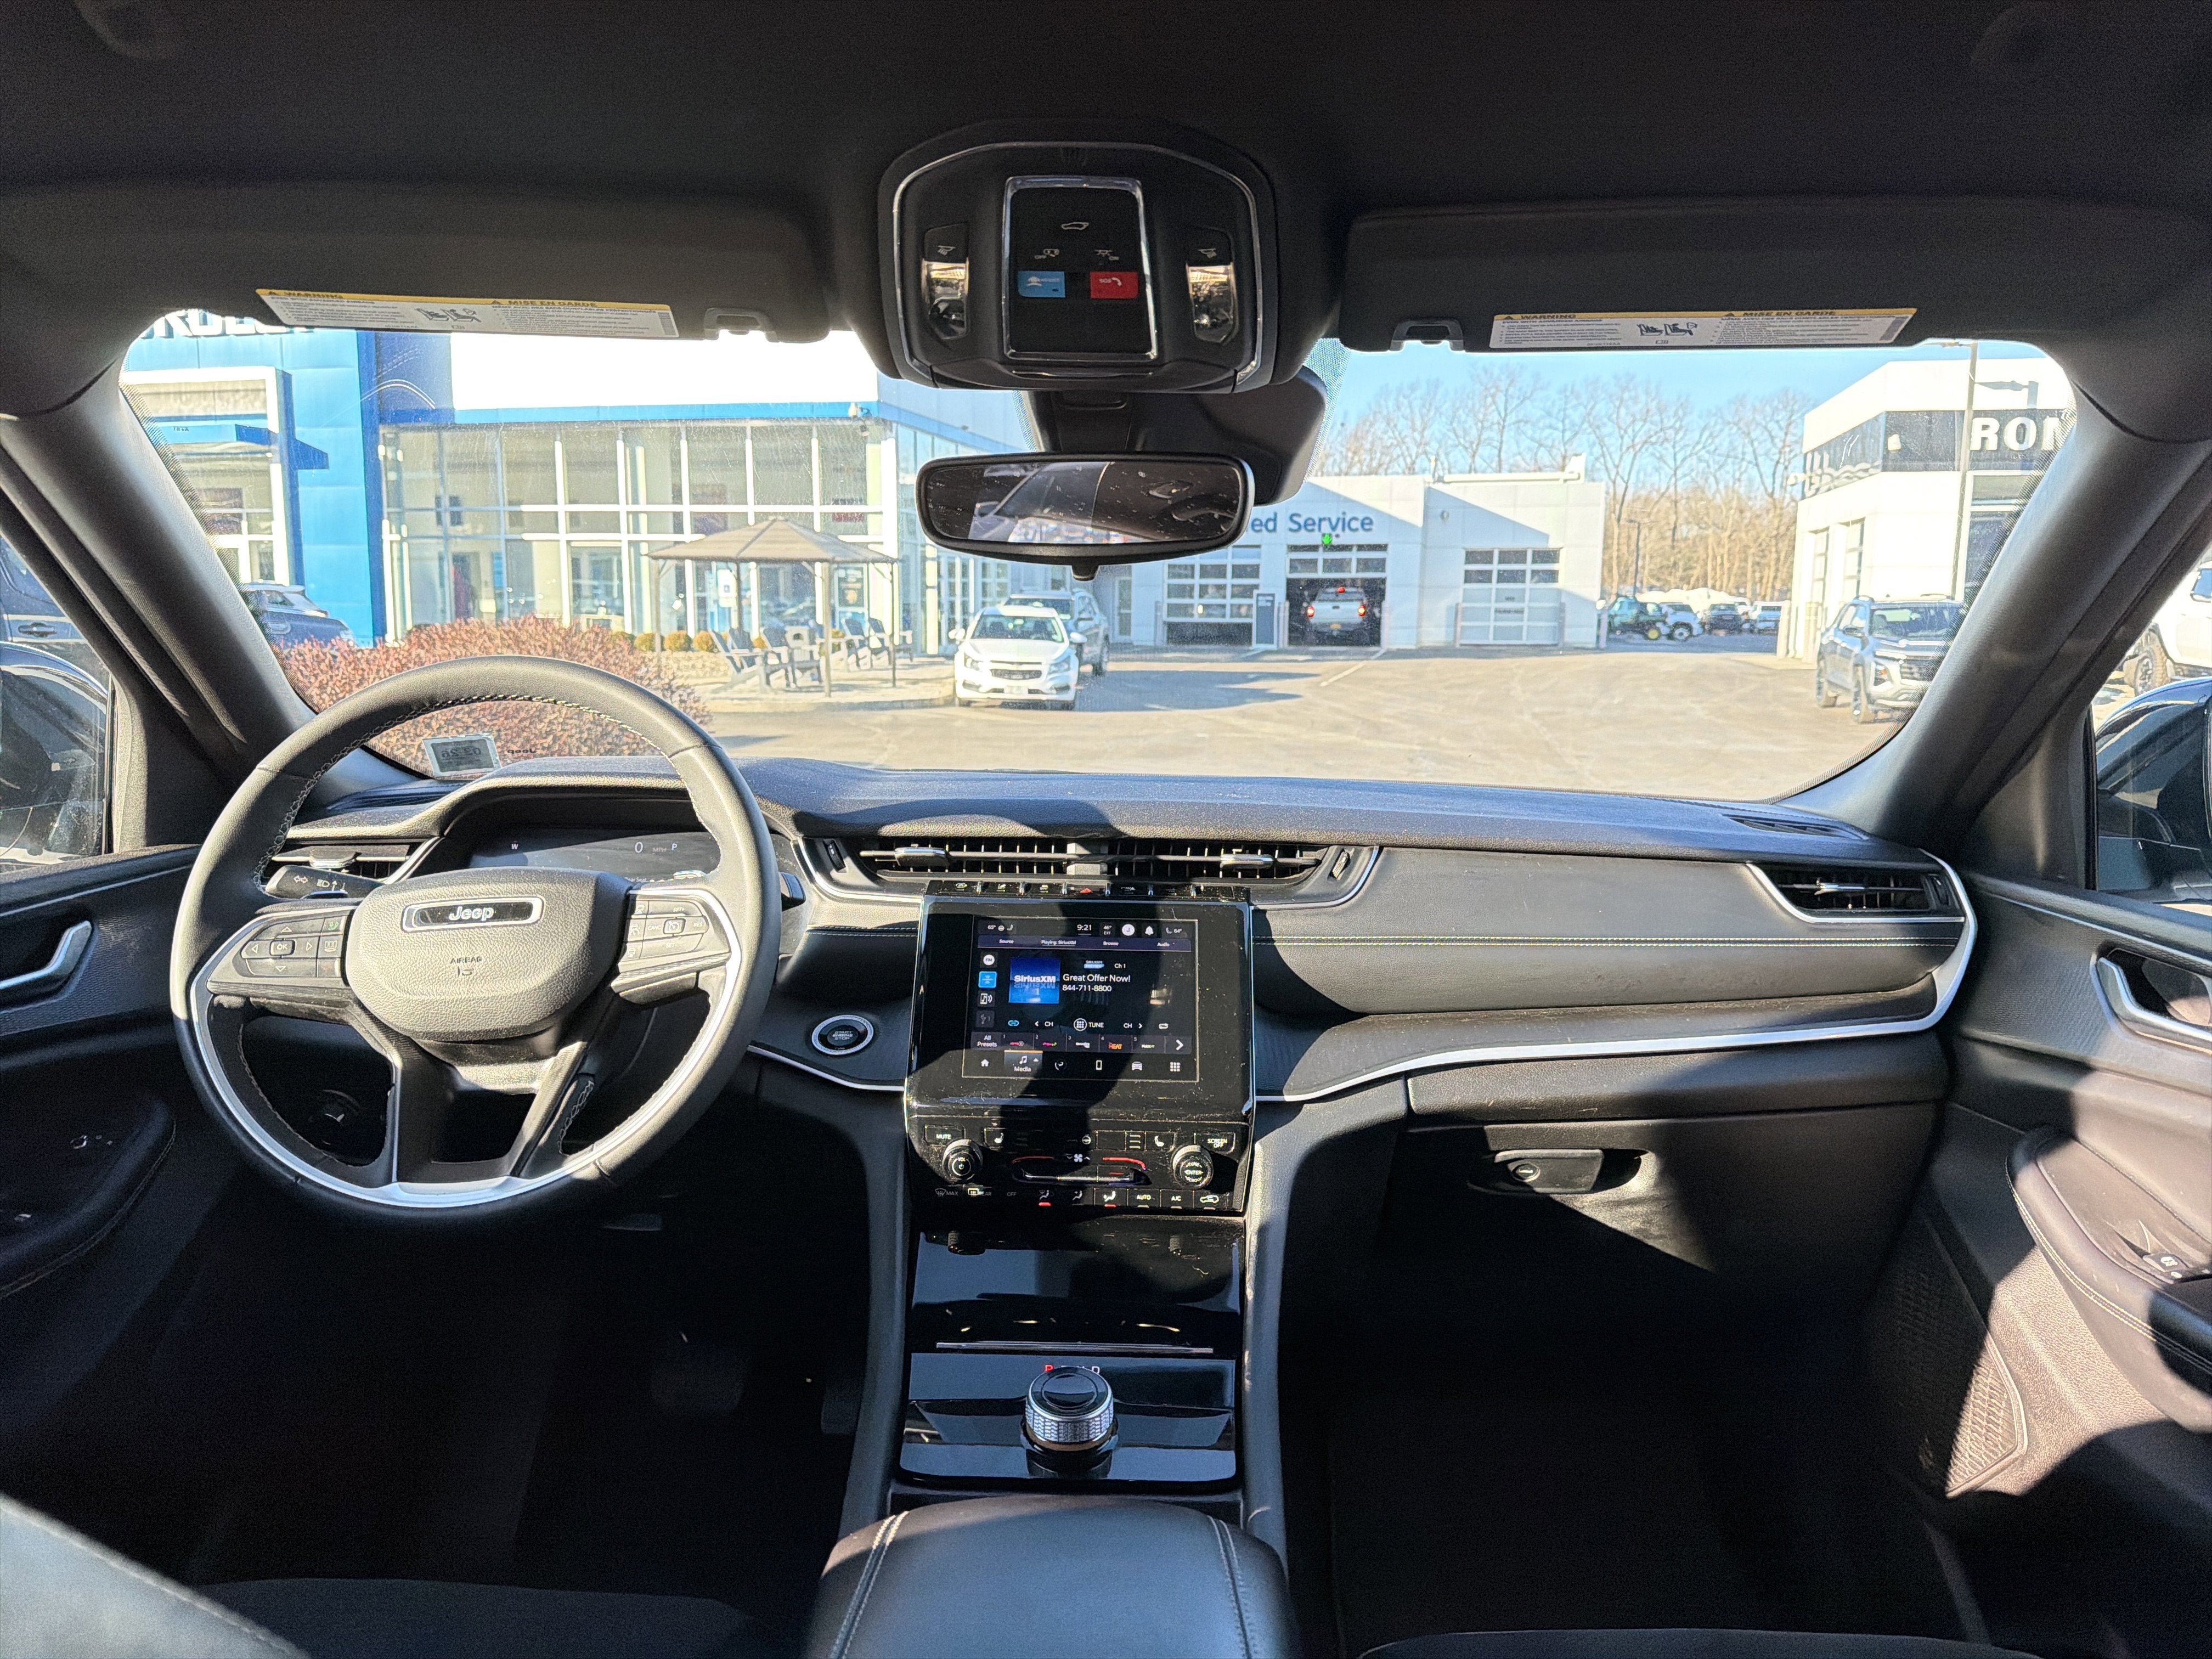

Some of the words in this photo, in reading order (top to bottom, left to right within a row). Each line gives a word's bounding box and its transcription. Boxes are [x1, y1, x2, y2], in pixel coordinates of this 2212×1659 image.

[1249, 511, 1278, 533] ed
[1288, 511, 1374, 533] Service
[634, 841, 644, 853] 0
[671, 843, 678, 851] P
[449, 906, 494, 922] Jeep
[1014, 975, 1056, 983] SiriusXM
[1063, 974, 1086, 982] Great
[1087, 974, 1108, 982] Offer
[1109, 974, 1131, 983] Now!
[1062, 984, 1112, 992] 844-711-8800
[1091, 1366, 1100, 1374] D
